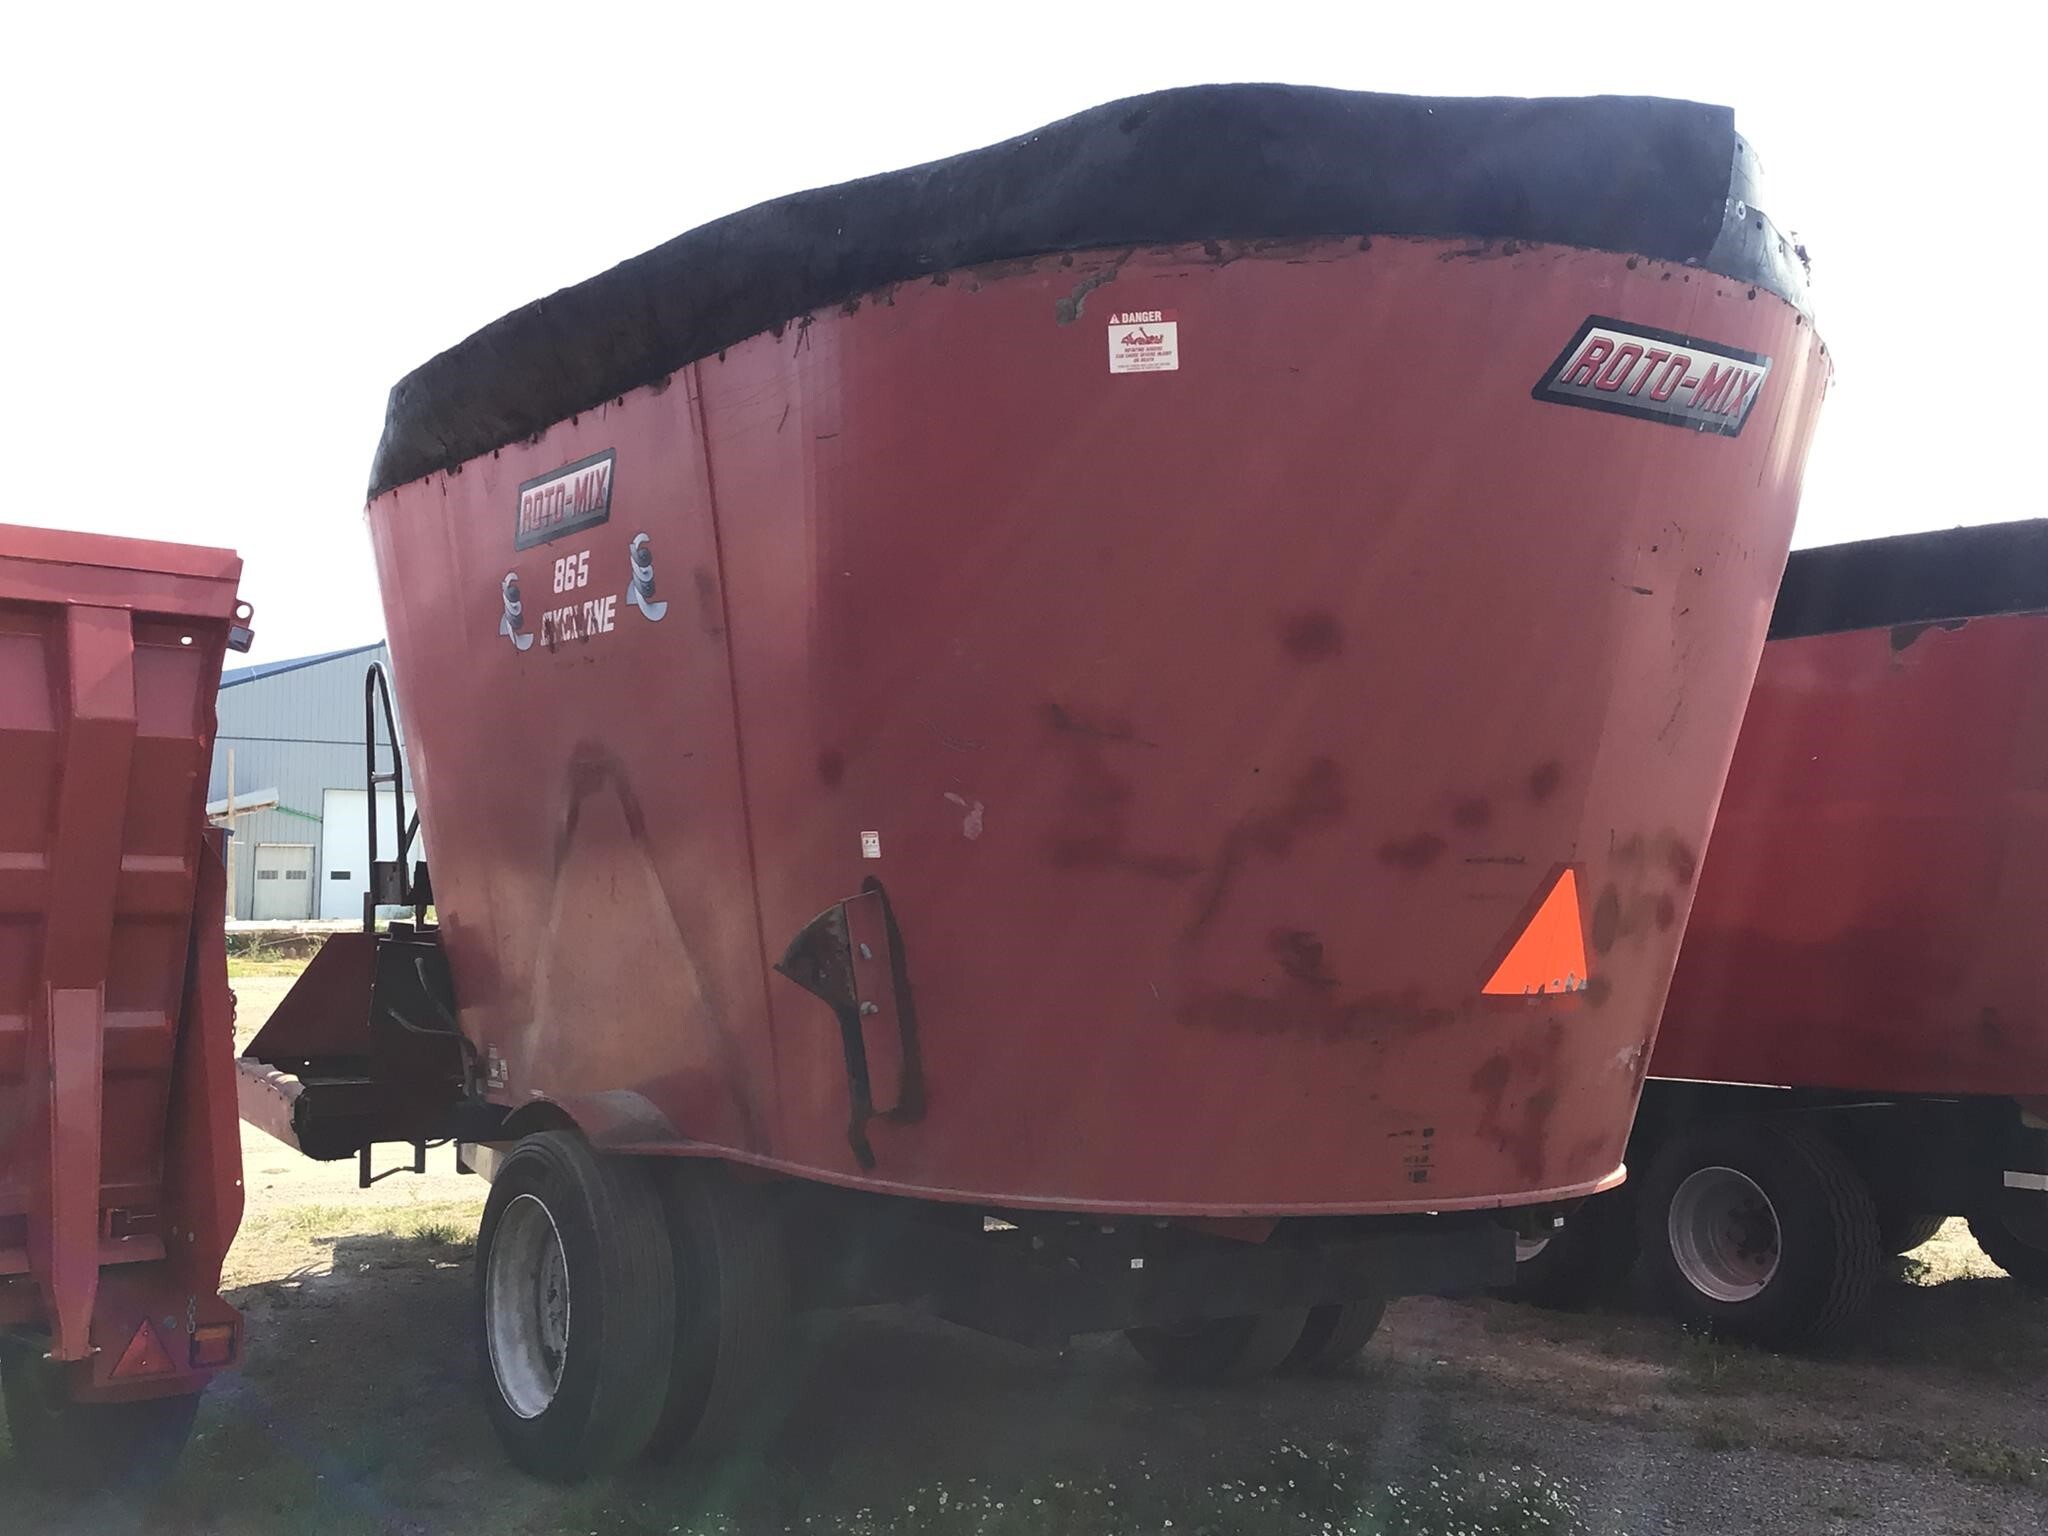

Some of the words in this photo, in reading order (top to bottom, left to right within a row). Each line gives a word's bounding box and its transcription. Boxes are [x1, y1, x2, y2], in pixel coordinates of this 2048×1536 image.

[1121, 311, 1162, 324] DANGER
[1560, 335, 1761, 418] ROTO-MIX
[520, 464, 610, 536] ROTO-MIX
[553, 550, 590, 594] 865
